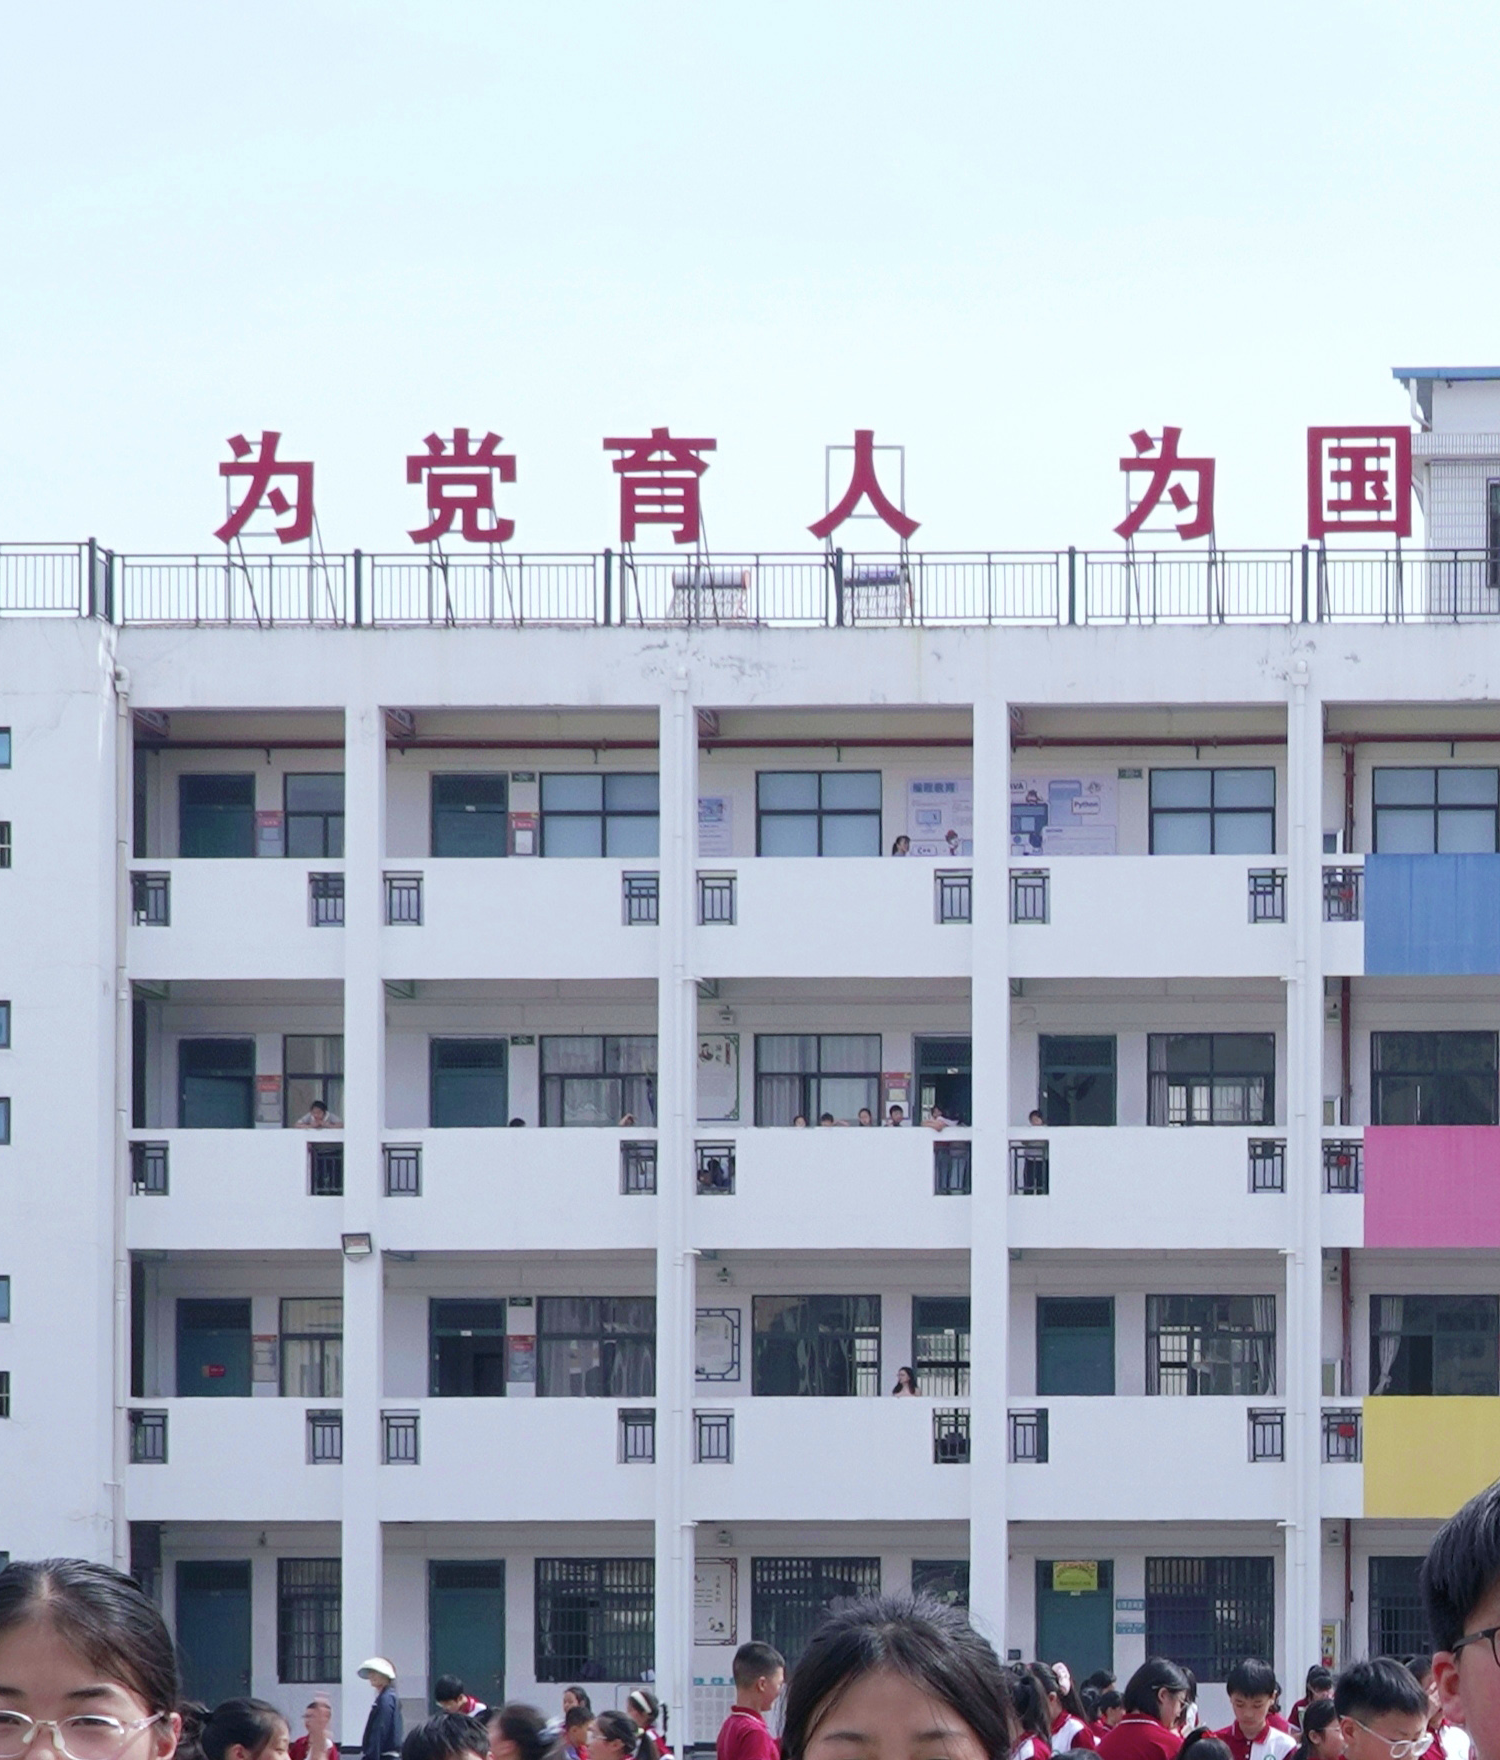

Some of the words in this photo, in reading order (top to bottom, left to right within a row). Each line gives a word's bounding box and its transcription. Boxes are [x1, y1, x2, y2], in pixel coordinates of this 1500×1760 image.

[217, 426, 921, 545] 为党育人
[1074, 800, 1099, 811] Python
